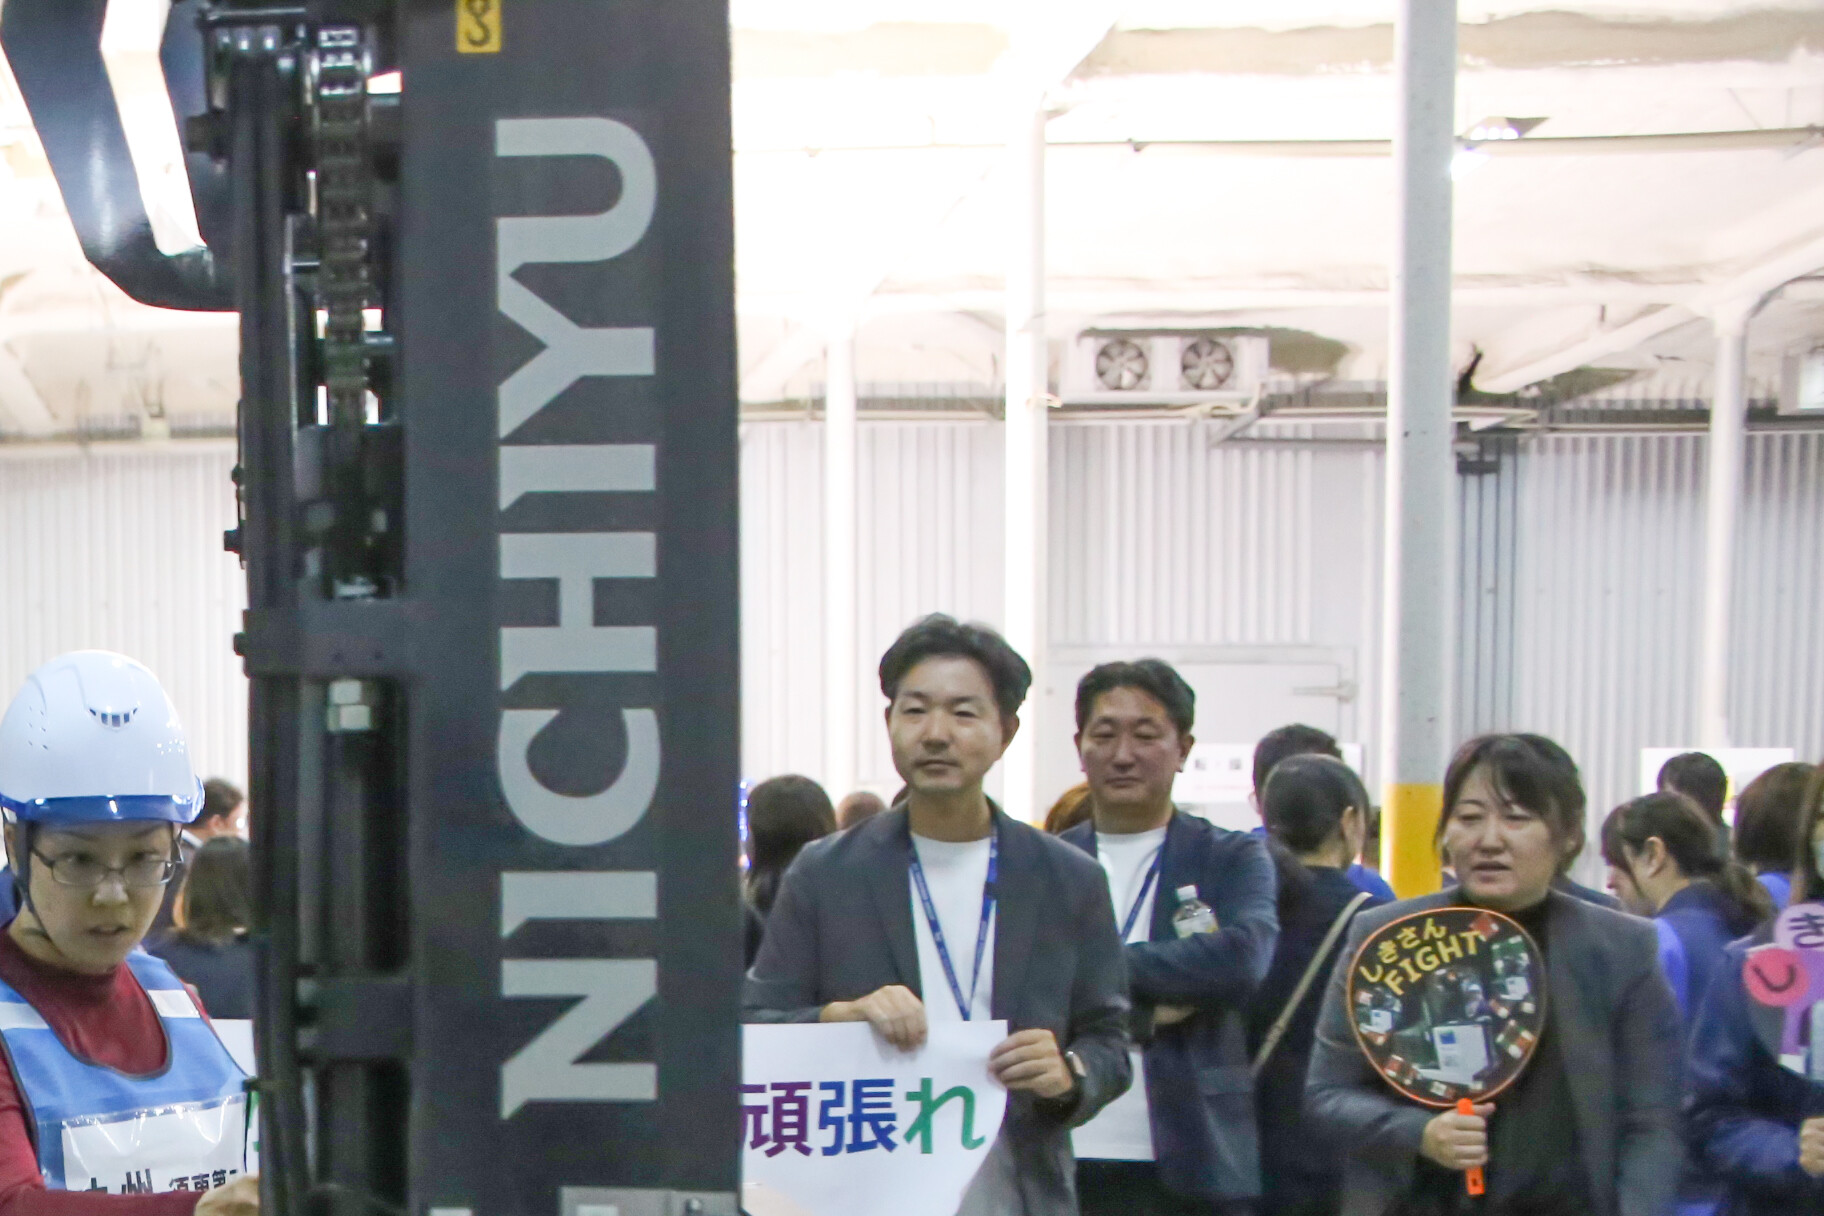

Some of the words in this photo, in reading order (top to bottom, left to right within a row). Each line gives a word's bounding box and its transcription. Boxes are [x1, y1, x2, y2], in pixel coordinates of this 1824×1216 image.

[496, 116, 660, 1119] NICHIYU
[1383, 929, 1482, 997] FIGHT
[736, 1077, 986, 1158] 頑張れ
